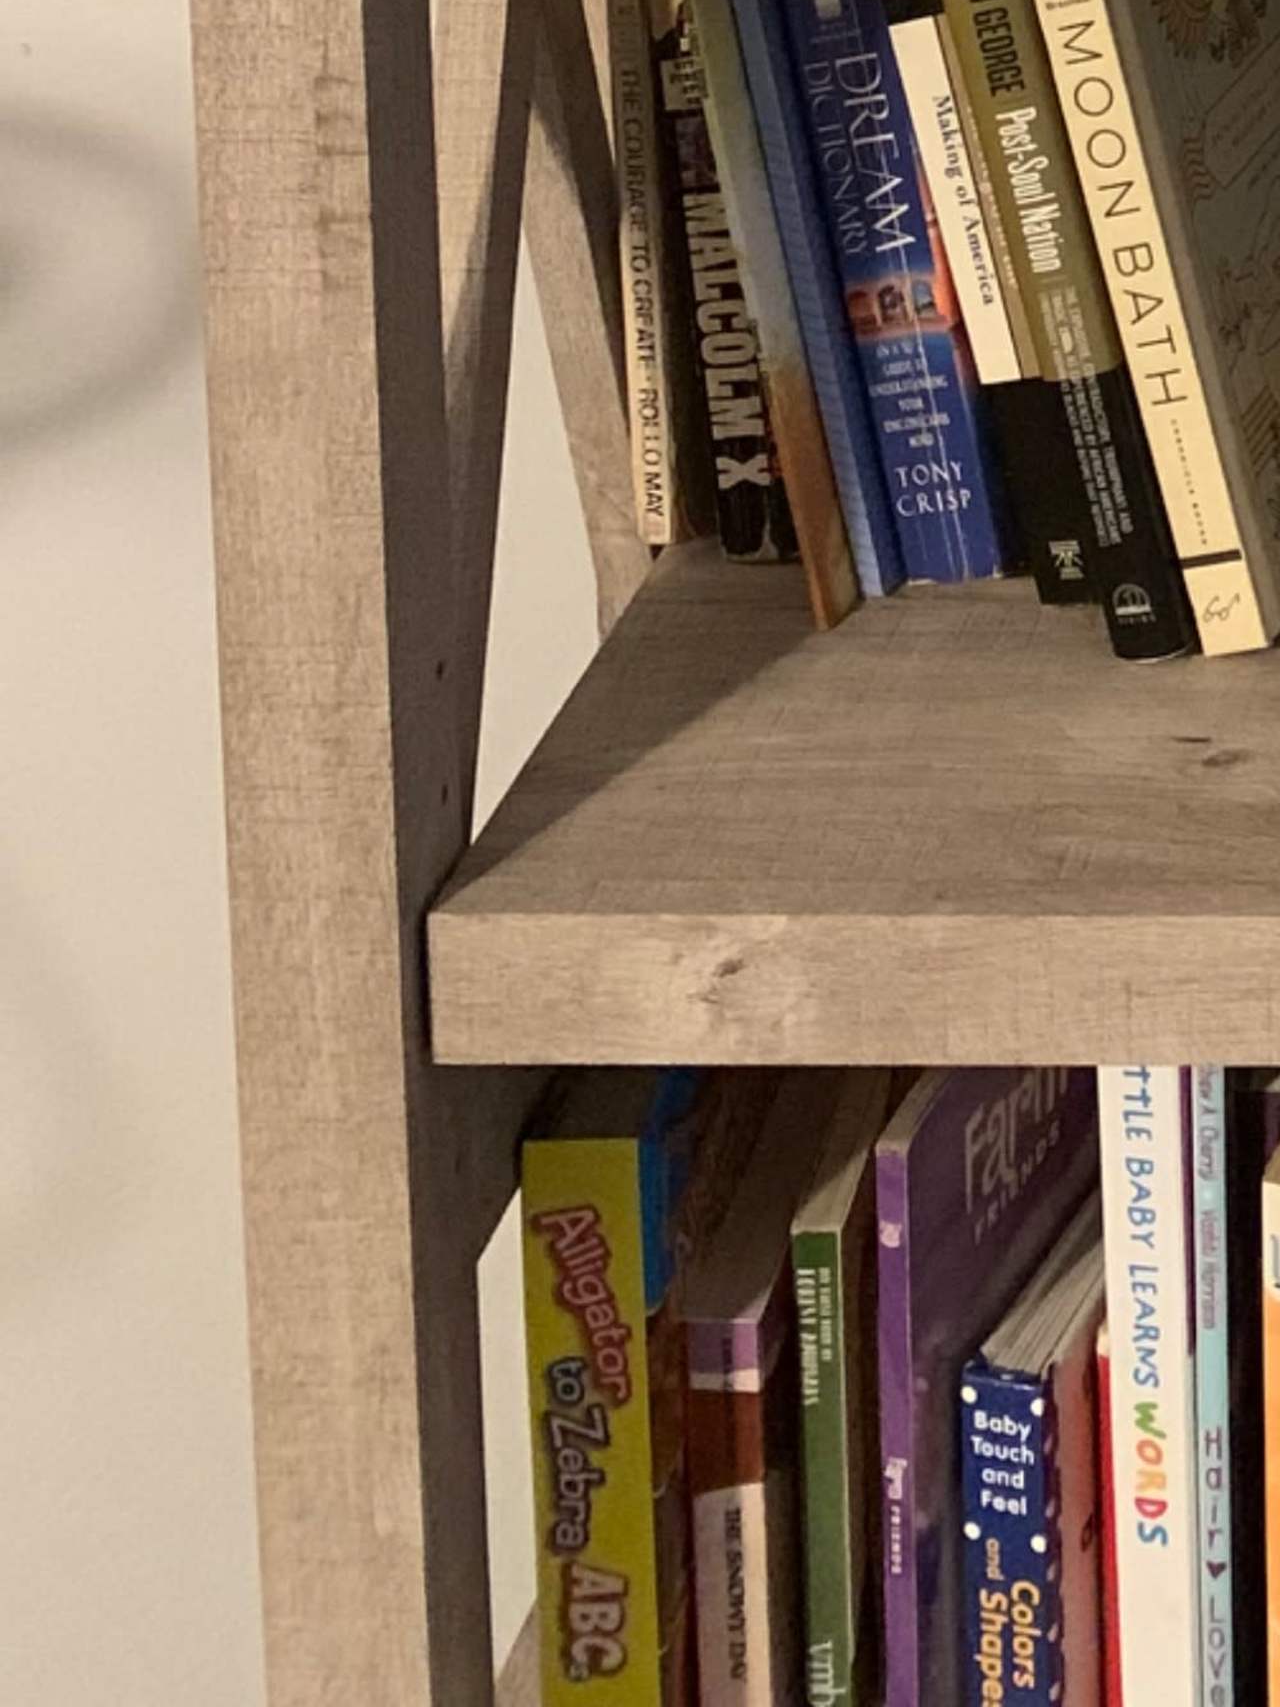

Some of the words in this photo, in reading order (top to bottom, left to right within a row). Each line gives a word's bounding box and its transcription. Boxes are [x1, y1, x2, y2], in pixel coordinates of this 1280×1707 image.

[972, 3, 1027, 99] GEORGE
[802, 59, 870, 256] DICTIONARY
[832, 51, 918, 255] DREAM
[931, 92, 965, 181] Making
[957, 182, 976, 208] of
[1055, 17, 1143, 222] MOON
[1110, 239, 1190, 410] BATH
[961, 208, 998, 307] America
[681, 192, 766, 440] MALCOLM
[643, 471, 665, 518] MAY
[715, 453, 772, 490] X
[895, 461, 964, 489] TONY
[895, 487, 972, 519] CRISP
[1122, 1155, 1157, 1252] BABY
[531, 1204, 630, 1405] Alligator
[1125, 1262, 1162, 1389] LEARNS
[968, 1434, 1036, 1467] Touch
[971, 1409, 1033, 1443] Baby
[547, 1401, 612, 1552] Zebra
[978, 1489, 1028, 1517] Feel
[980, 1466, 1026, 1491] and
[1132, 1400, 1169, 1548] WORDS
[726, 1507, 742, 1539] THE
[985, 1538, 1006, 1581] and
[725, 1548, 746, 1639] SNOWY
[1009, 1578, 1042, 1689] Colors
